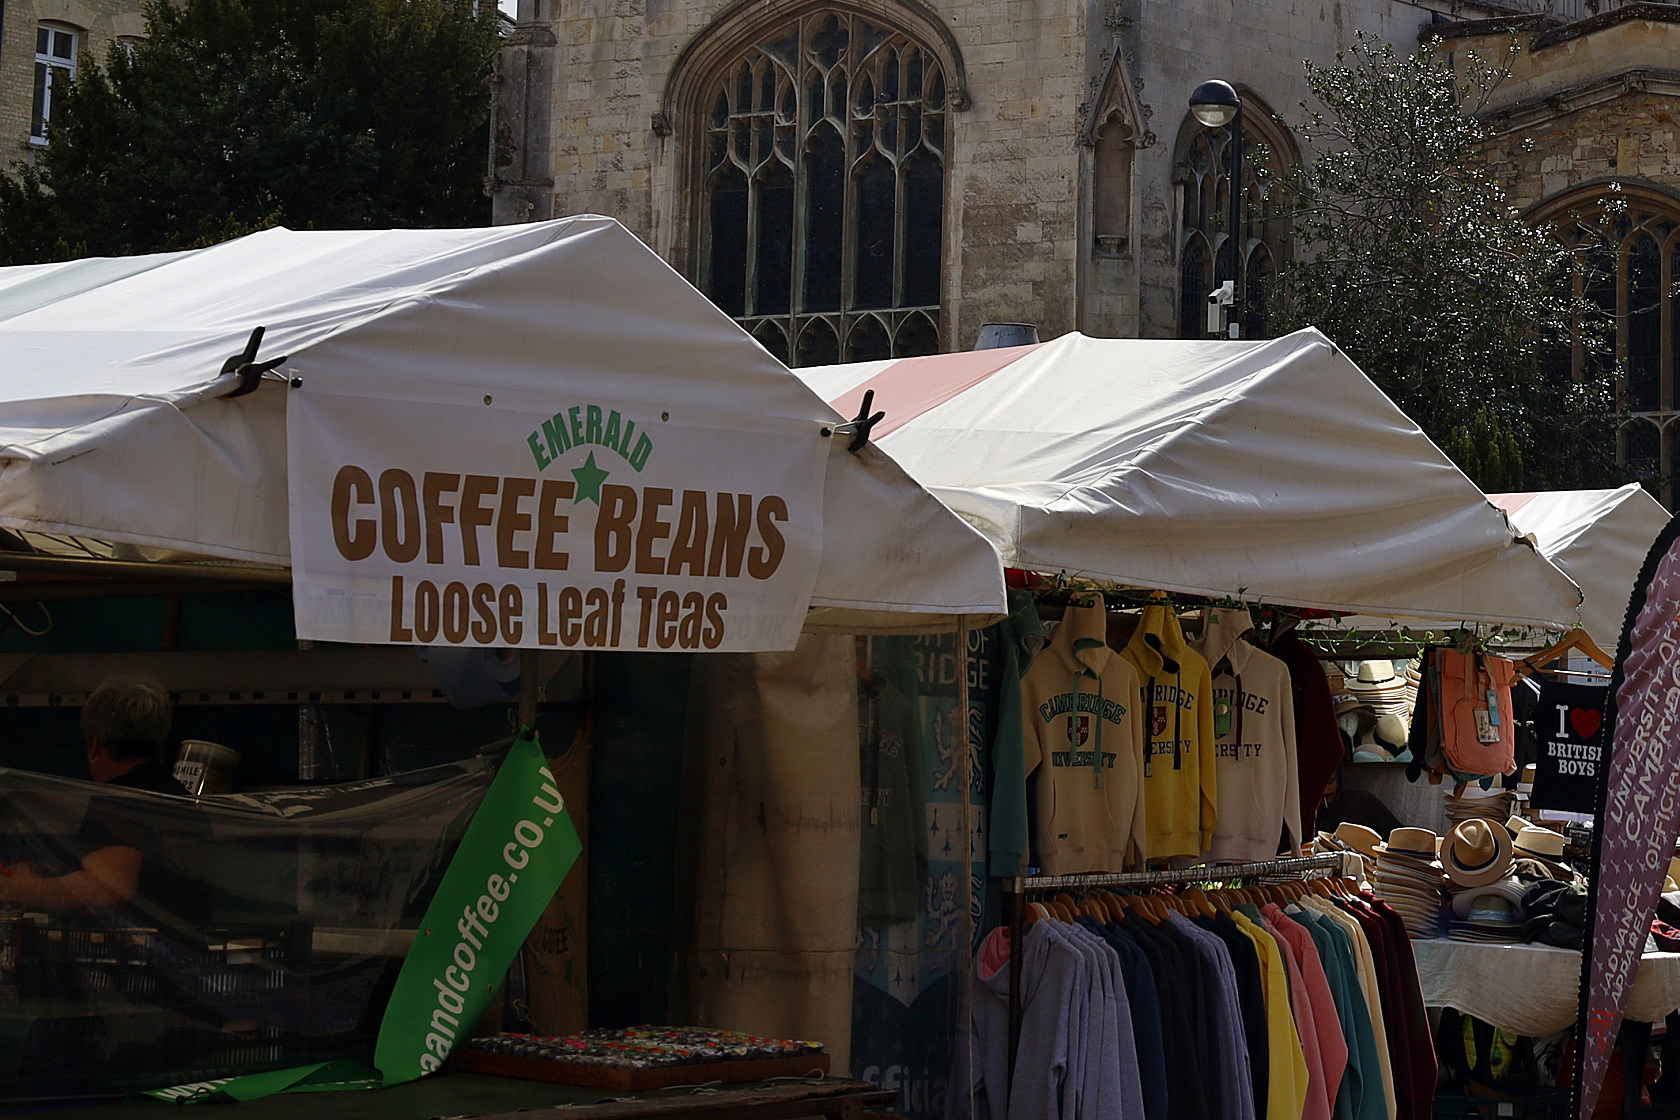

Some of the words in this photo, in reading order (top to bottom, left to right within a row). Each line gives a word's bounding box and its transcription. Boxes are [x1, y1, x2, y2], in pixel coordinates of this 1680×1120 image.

[527, 404, 654, 473] EMERALD
[331, 464, 576, 571] COFFEE
[593, 483, 789, 580] BEANS
[537, 578, 626, 647] Leaf
[636, 586, 728, 649] Teas
[1555, 704, 1570, 739] I
[1558, 759, 1596, 777] BOYS
[1611, 667, 1666, 823] UNIVERSITY
[420, 765, 565, 1077] aandcoffee.co.u
[1604, 877, 1642, 989] ADVANCE
[1611, 906, 1650, 1010] APPAREL
